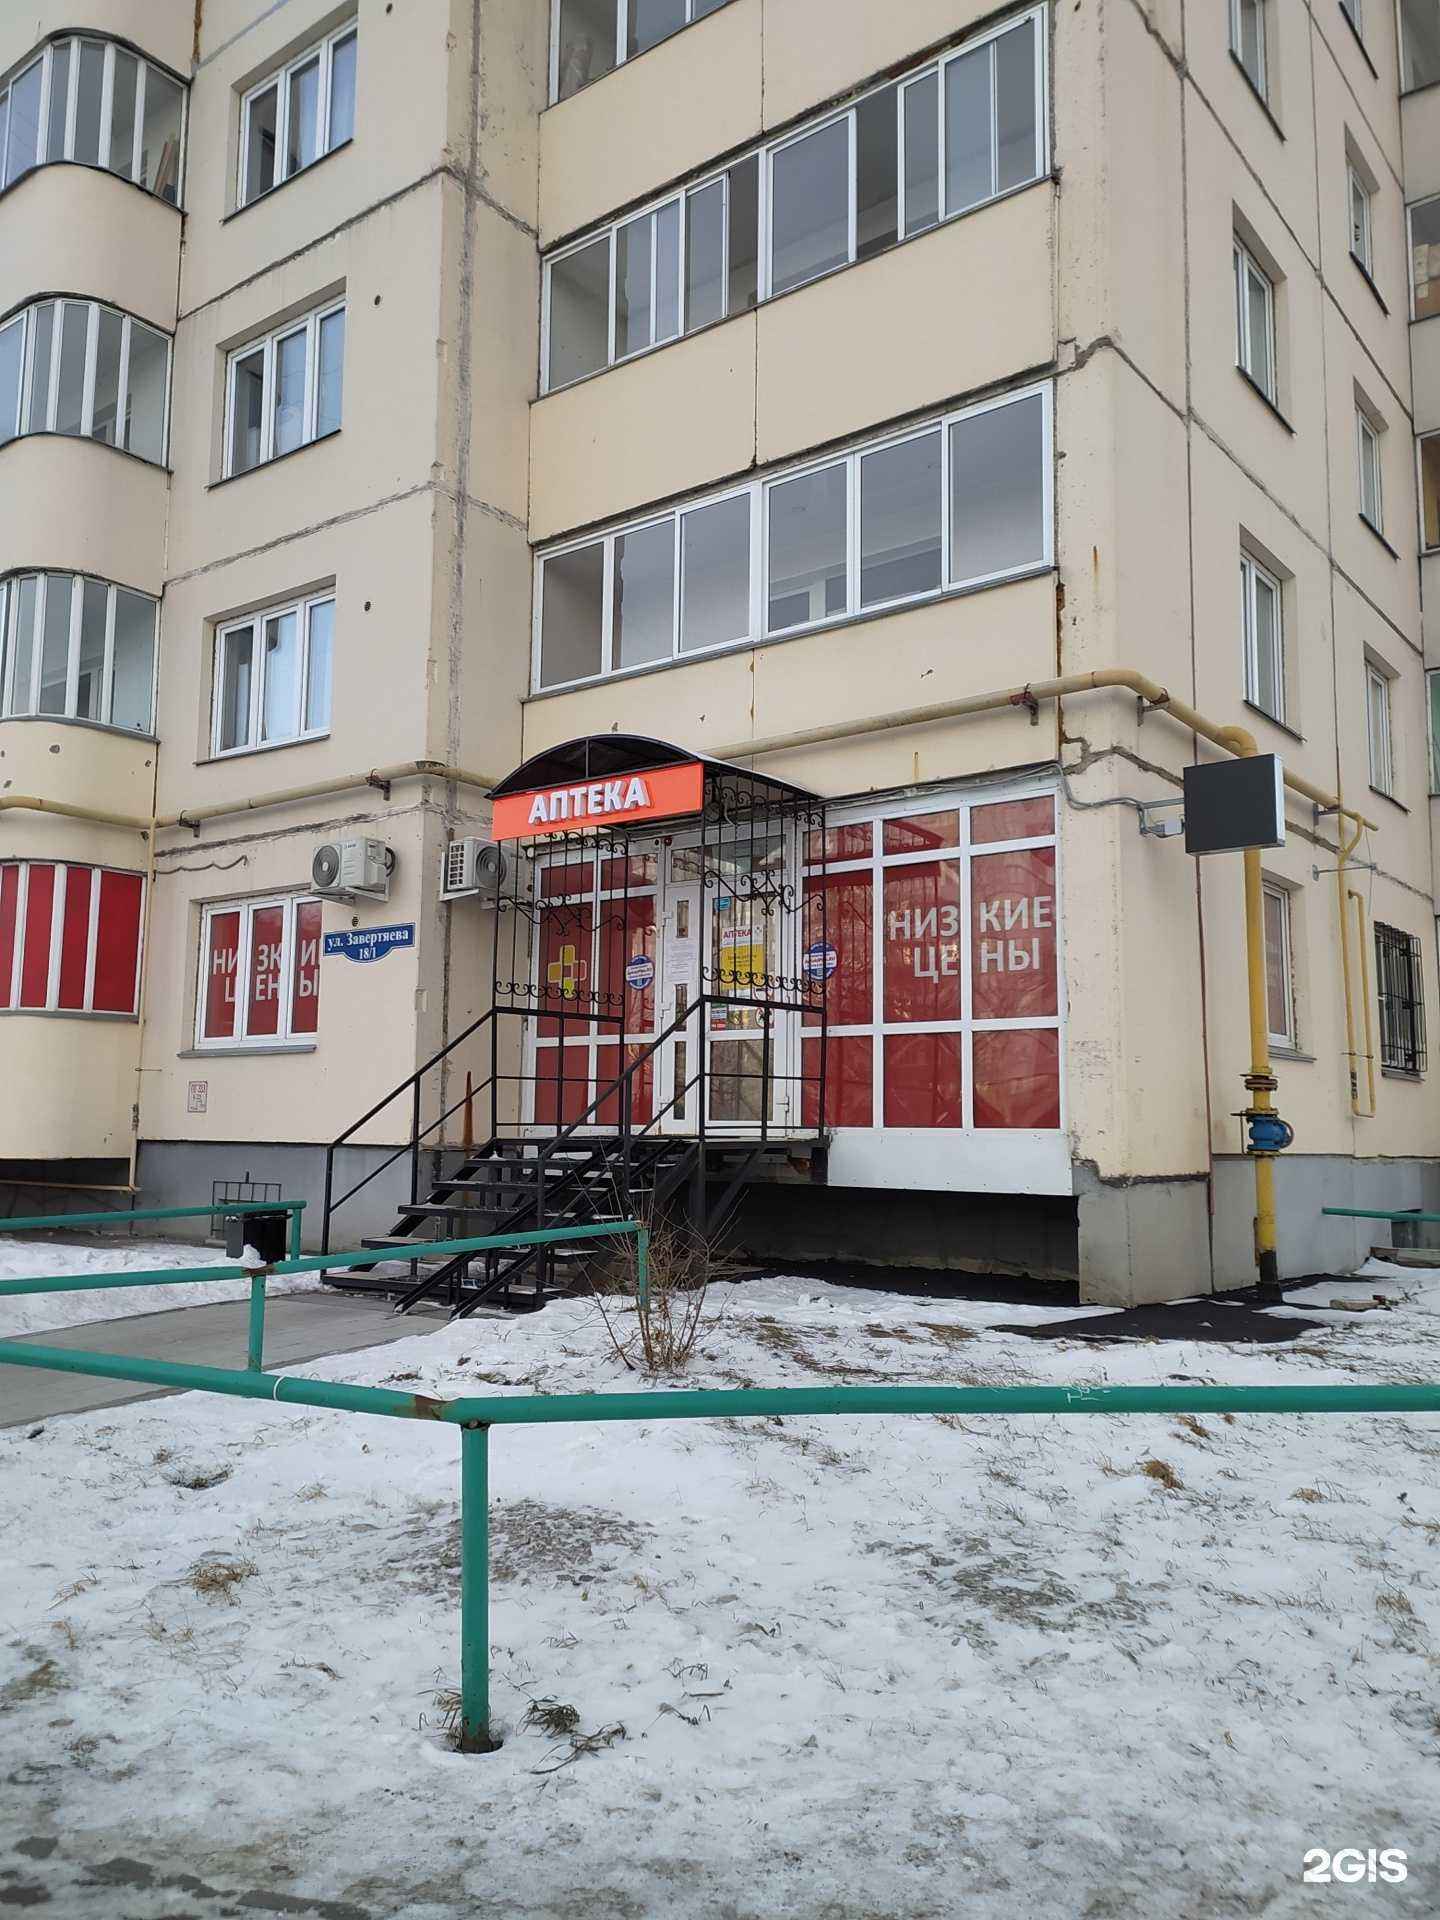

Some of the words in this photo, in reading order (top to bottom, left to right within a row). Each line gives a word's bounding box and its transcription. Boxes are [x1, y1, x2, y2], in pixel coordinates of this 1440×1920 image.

[528, 777, 651, 824] АПТЕКА
[327, 937, 344, 951] ул.
[346, 929, 409, 947] Завертяева
[359, 946, 376, 960] 18/1
